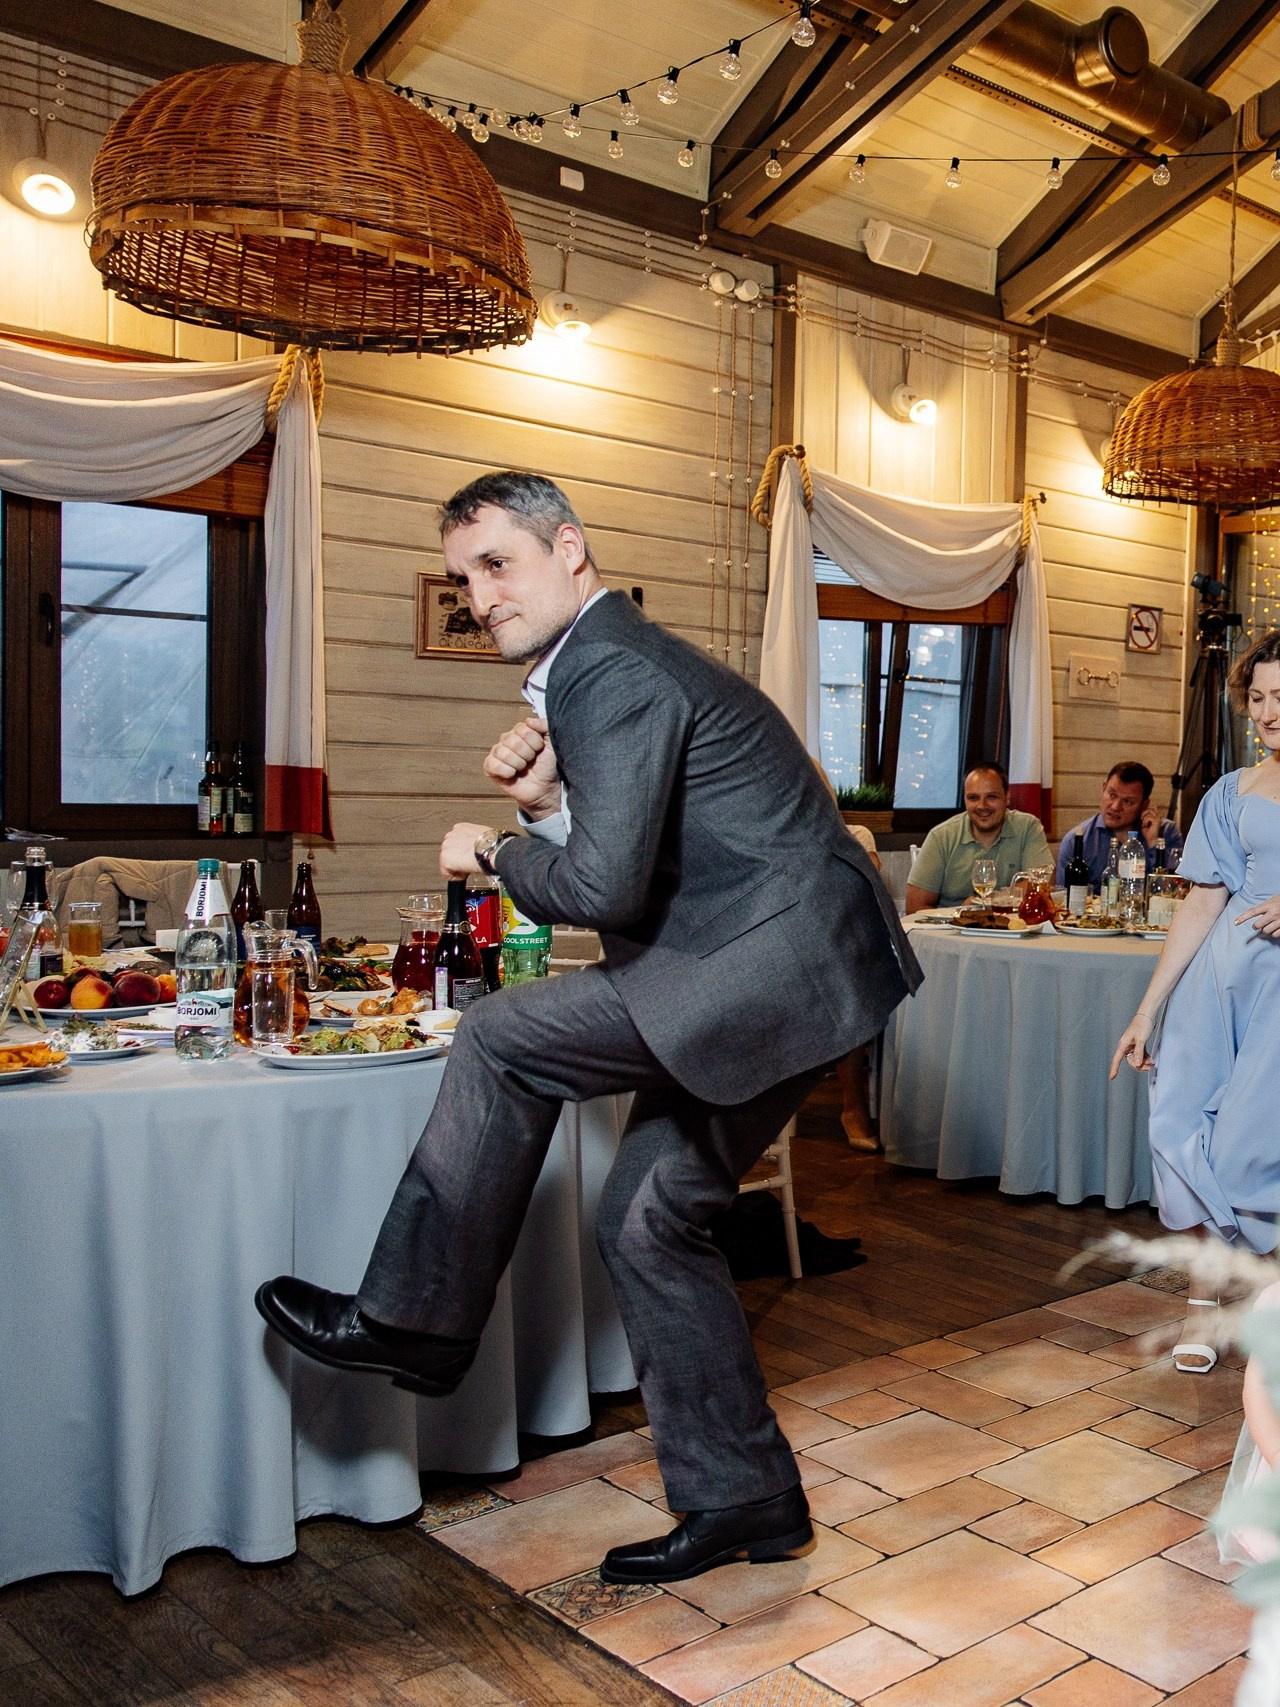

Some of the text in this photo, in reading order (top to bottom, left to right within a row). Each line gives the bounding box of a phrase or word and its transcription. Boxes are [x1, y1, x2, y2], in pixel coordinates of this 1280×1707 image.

[195, 881, 207, 917] BORJOMI
[475, 936, 488, 944] LA
[519, 936, 548, 945] STREET
[177, 1006, 217, 1016] BORJOMI
